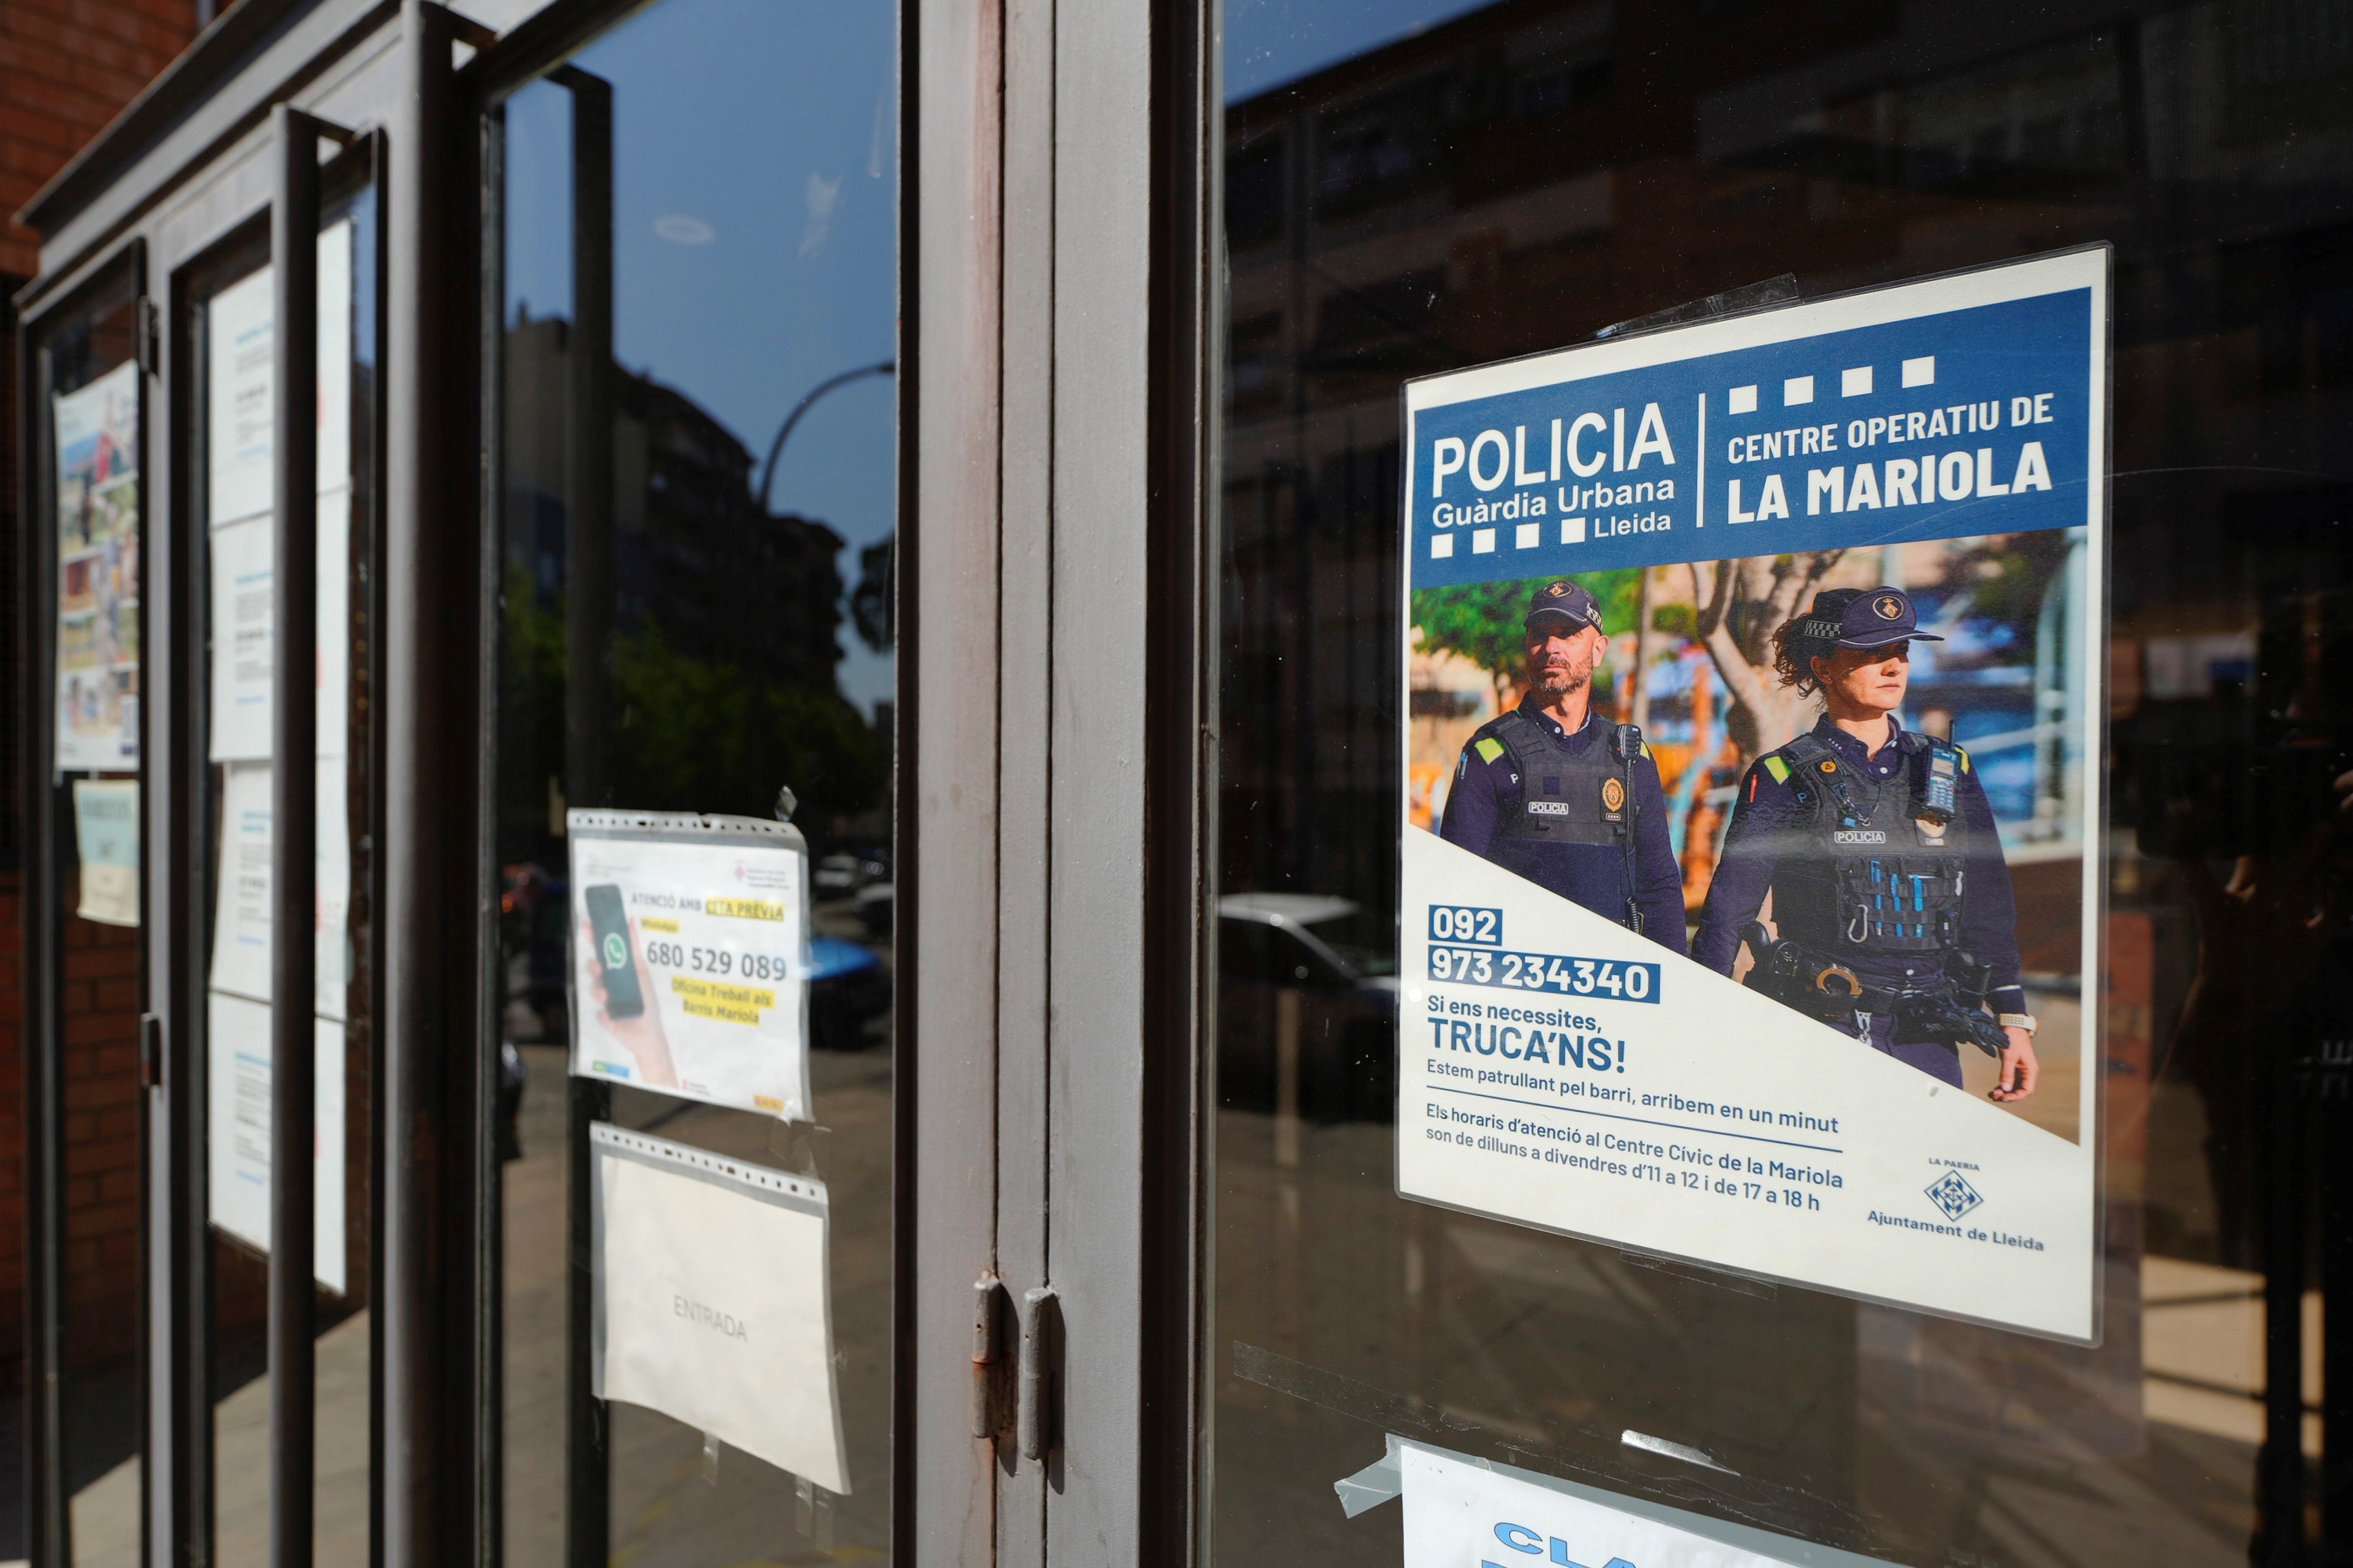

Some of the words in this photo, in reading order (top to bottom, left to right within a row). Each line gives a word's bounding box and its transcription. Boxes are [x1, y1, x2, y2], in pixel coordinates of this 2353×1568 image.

[1728, 422, 1837, 464] CENTRE
[1846, 401, 1999, 446] OPERATIU
[2011, 393, 2053, 426] DE
[1433, 401, 1675, 498] POLICIA
[1727, 471, 1789, 525] LA
[1807, 441, 2052, 516] MARIOLA
[1432, 491, 1547, 529] Guàrdia
[1558, 479, 1675, 513] Urbana
[1594, 512, 1671, 538] Lleida
[1530, 803, 1567, 814] POLICIA
[1837, 832, 1883, 842] POLICIA
[631, 893, 675, 909] ATENCIÓ
[678, 898, 701, 911] AMB
[706, 900, 732, 915] CITA
[738, 900, 783, 918] PRÈVIA
[1433, 908, 1497, 942] 092
[647, 941, 683, 967] 680
[692, 949, 731, 974] 529
[741, 956, 786, 981] 089
[1432, 949, 1492, 983] 973
[1502, 955, 1650, 999] 234340
[672, 978, 706, 996] Oficina
[711, 985, 749, 1003] Treball
[753, 992, 771, 1005] als
[683, 1000, 713, 1016] Barris
[717, 1005, 759, 1023] Mariola
[1428, 995, 1444, 1013] Si
[1449, 1001, 1482, 1017] ens
[1487, 1004, 1601, 1034] necessites,
[1427, 1059, 1473, 1079] Estem
[1478, 1070, 1554, 1091] patrullant
[1560, 1082, 1585, 1096] pel
[1590, 1083, 1636, 1104] barri,
[1642, 1093, 1714, 1115] arribem
[1720, 1103, 1743, 1120] en
[1749, 1107, 1772, 1124] un
[1779, 1112, 1839, 1133] minut
[1426, 1103, 1448, 1120] Els
[1451, 1107, 1504, 1131] horaris
[1508, 1119, 1581, 1143] d'atenció
[1586, 1129, 1600, 1147] al
[1604, 1134, 1664, 1158] Centre
[1669, 1144, 1714, 1167] Cívic
[1718, 1153, 1742, 1172] de
[1747, 1158, 1763, 1176] la
[1769, 1160, 1843, 1189] Mariola
[1929, 1158, 1941, 1166] LA
[1944, 1160, 1980, 1171] PAERIA
[1426, 1128, 1453, 1143] son
[1455, 1131, 1473, 1147] de
[1478, 1135, 1527, 1158] dilluns
[1532, 1149, 1541, 1160] a
[1545, 1147, 1627, 1176] divendres
[1632, 1162, 1661, 1183] d'11
[1665, 1172, 1675, 1185] a
[1681, 1171, 1699, 1189] 12
[1704, 1174, 1709, 1192] i
[1714, 1177, 1737, 1196] de
[1743, 1180, 1761, 1200] 17
[1765, 1189, 1777, 1203] a
[1783, 1189, 1802, 1207] 18
[1808, 1193, 1819, 1211] h
[1868, 1210, 1962, 1237] Ajuntament
[1968, 1228, 1987, 1241] de
[1993, 1232, 2044, 1251] Lleida
[674, 1295, 747, 1342] ENTRADA
